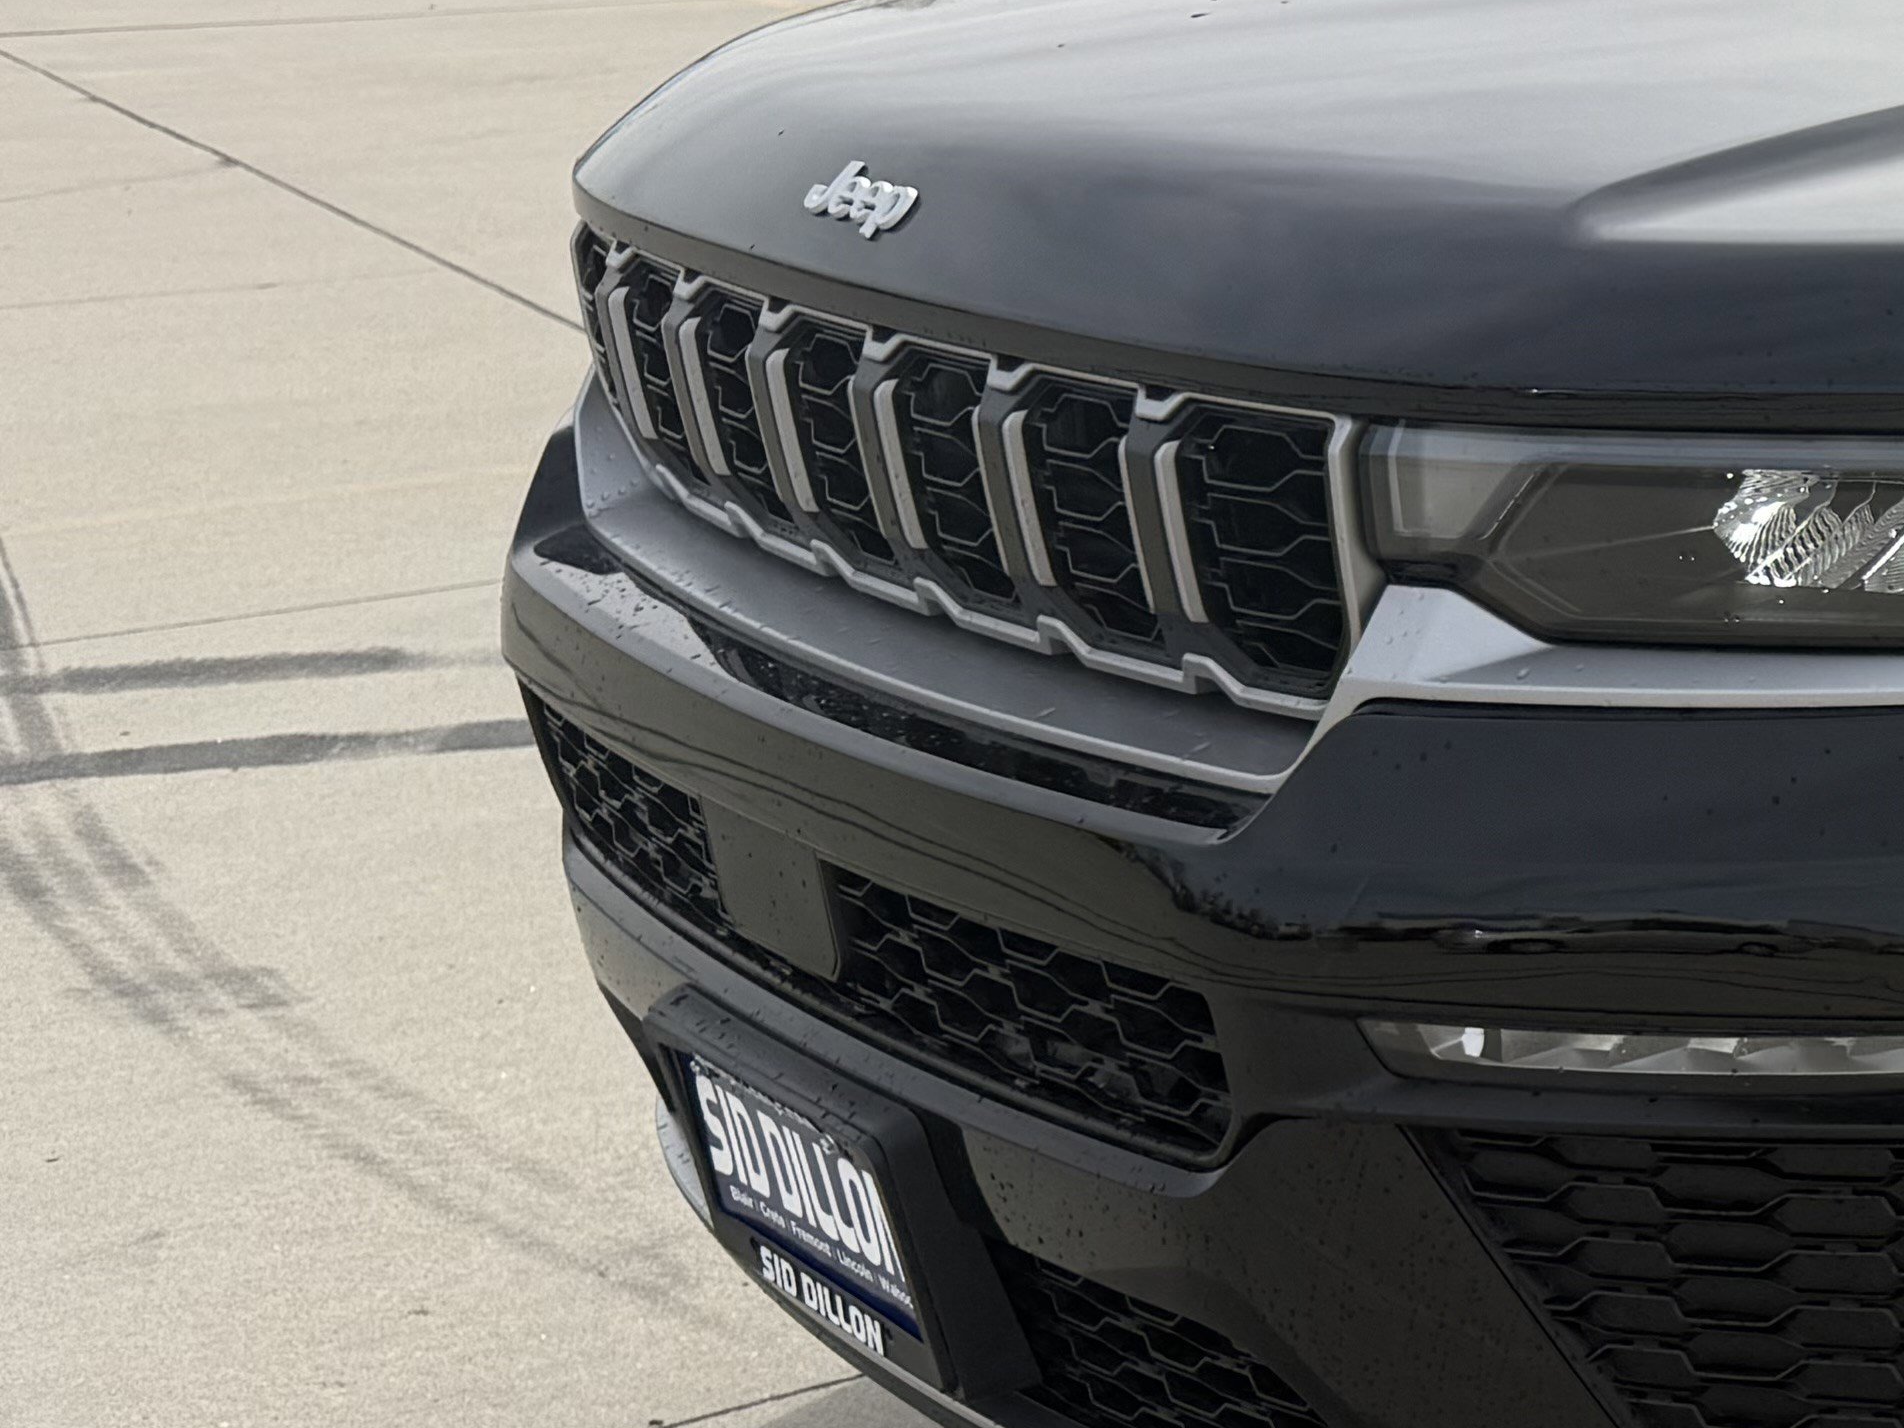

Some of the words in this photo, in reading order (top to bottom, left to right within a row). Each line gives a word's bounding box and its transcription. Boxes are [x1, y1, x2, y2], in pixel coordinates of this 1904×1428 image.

[804, 160, 919, 239] Jeep
[695, 1074, 770, 1199] SID
[757, 1109, 906, 1283] DILLON
[759, 1245, 798, 1297] SID
[800, 1271, 885, 1357] DILLON
